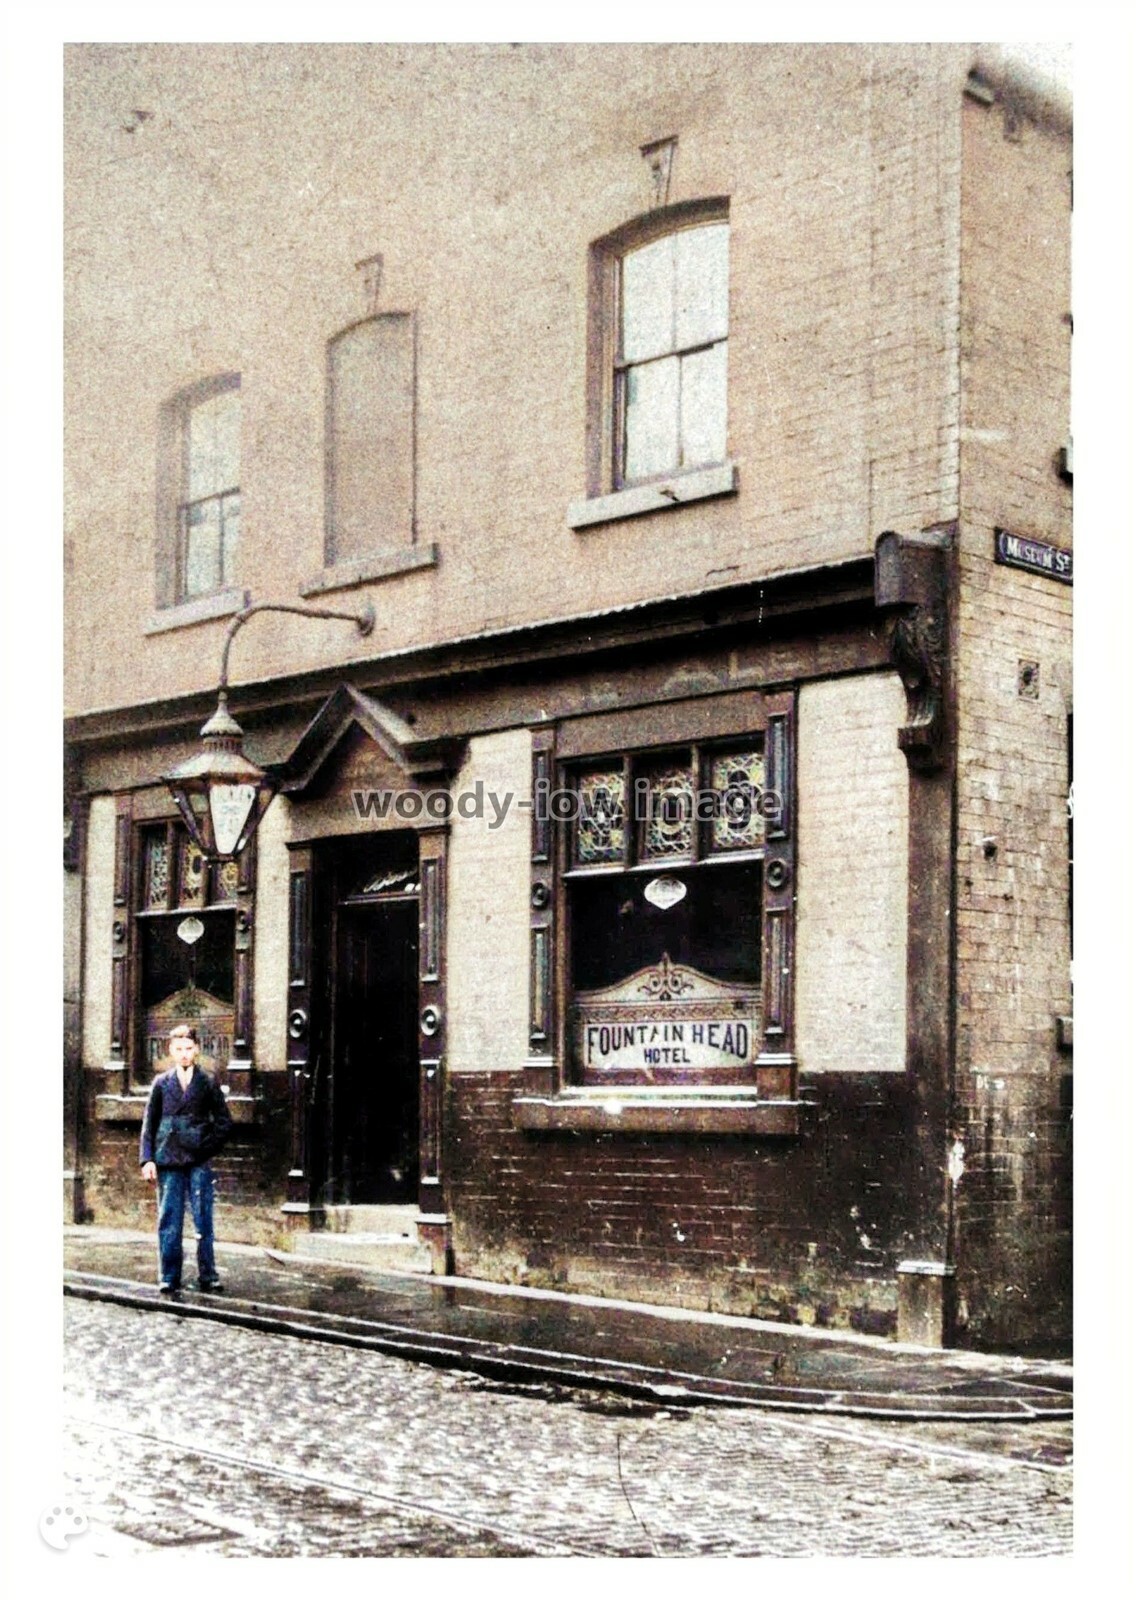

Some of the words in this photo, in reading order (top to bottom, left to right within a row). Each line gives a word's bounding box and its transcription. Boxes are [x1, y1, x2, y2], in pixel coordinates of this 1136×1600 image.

[587, 1024, 685, 1065] FOUNTAIN
[692, 1023, 749, 1060] HEAD
[643, 1047, 691, 1064] HOTEL
